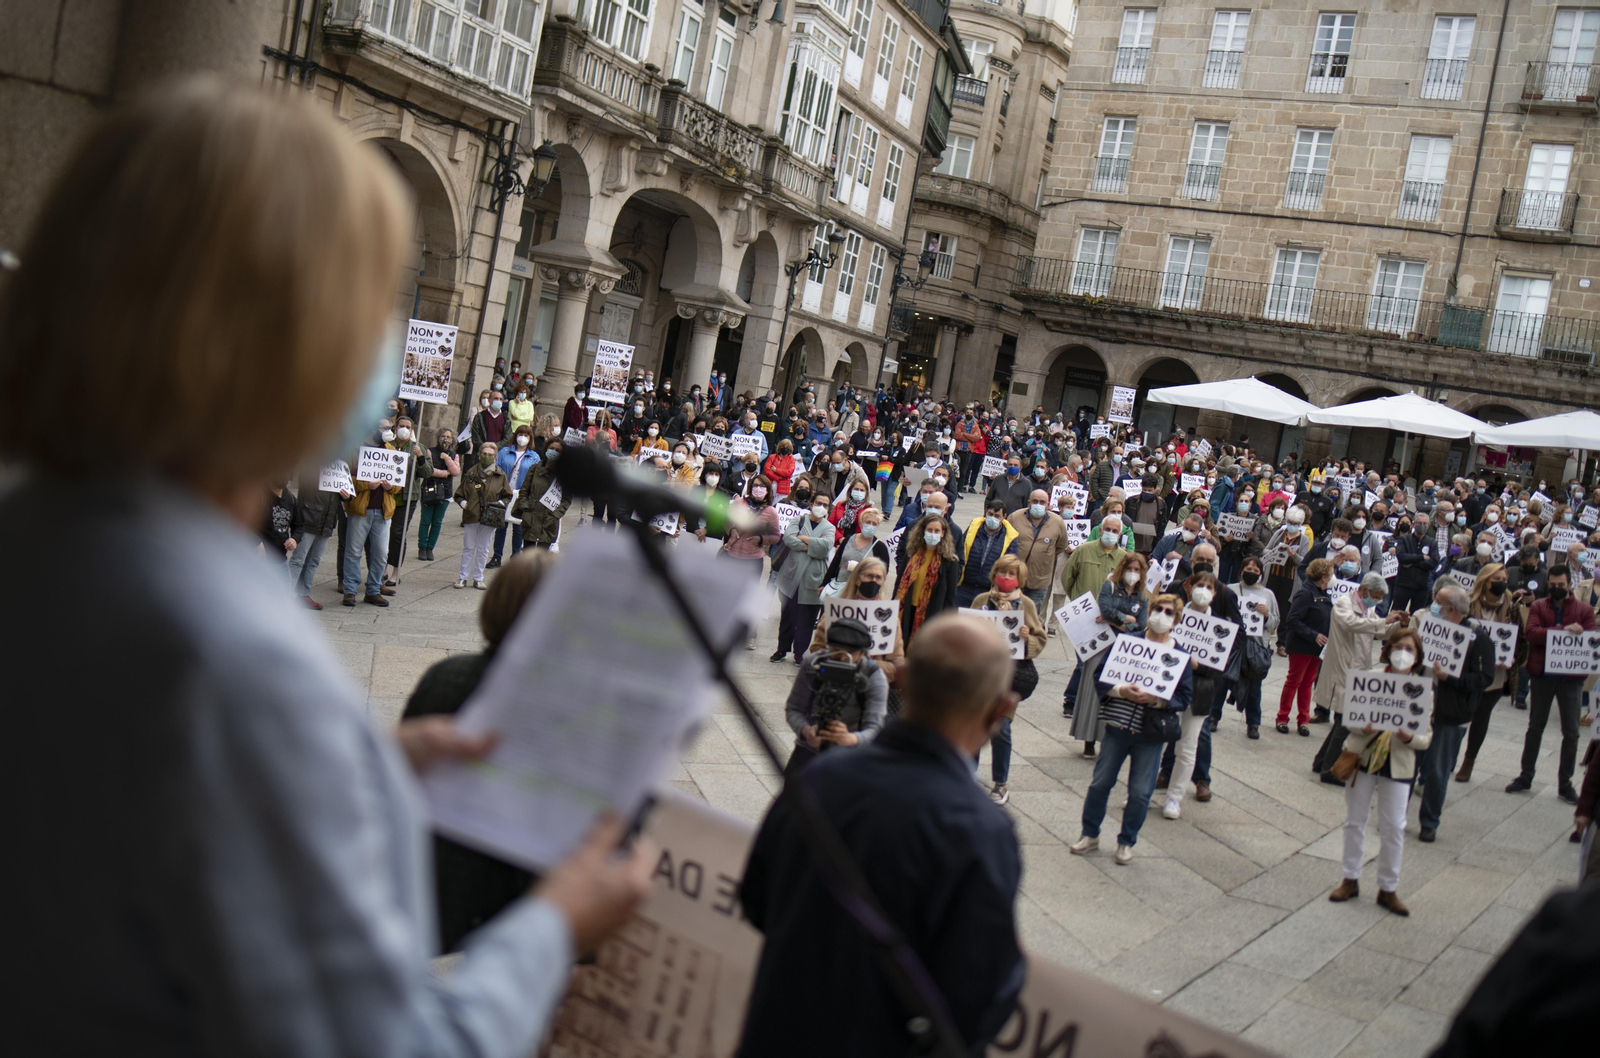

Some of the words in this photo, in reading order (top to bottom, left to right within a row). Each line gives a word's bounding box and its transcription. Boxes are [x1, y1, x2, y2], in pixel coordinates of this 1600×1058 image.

[512, 263, 526, 272] ación
[410, 326, 434, 338] NON
[418, 346, 437, 355] UPO
[600, 345, 617, 354] NON
[401, 387, 434, 397] QUEREMOS
[591, 390, 614, 398] QUEREMOS
[706, 435, 723, 445] NON
[363, 451, 389, 462] NON
[373, 472, 393, 481] UPO
[333, 481, 349, 490] UPO
[778, 507, 800, 516] NON
[1543, 503, 1554, 513] NON
[652, 518, 664, 527] PO
[886, 533, 903, 547] NO
[1230, 530, 1247, 538] NON
[1492, 527, 1506, 543] NON
[831, 604, 867, 621] NON
[1071, 605, 1080, 615] AO
[1060, 611, 1070, 623] DA
[1180, 613, 1209, 632] NON
[1423, 621, 1450, 640] NON
[1184, 630, 1213, 645] PECHE
[1552, 635, 1583, 647] NON
[1118, 641, 1157, 660] NON
[1431, 639, 1453, 652] PECHE
[1129, 658, 1161, 673] PECHE
[1428, 652, 1448, 667] UPO
[1565, 660, 1588, 669] UPO
[1107, 669, 1121, 680] DA
[1124, 671, 1153, 687] UPO
[1353, 677, 1396, 694] NON
[1350, 695, 1366, 704] AO
[1369, 696, 1406, 708] PECHE
[1349, 712, 1366, 722] DA
[1370, 711, 1403, 726] UPO
